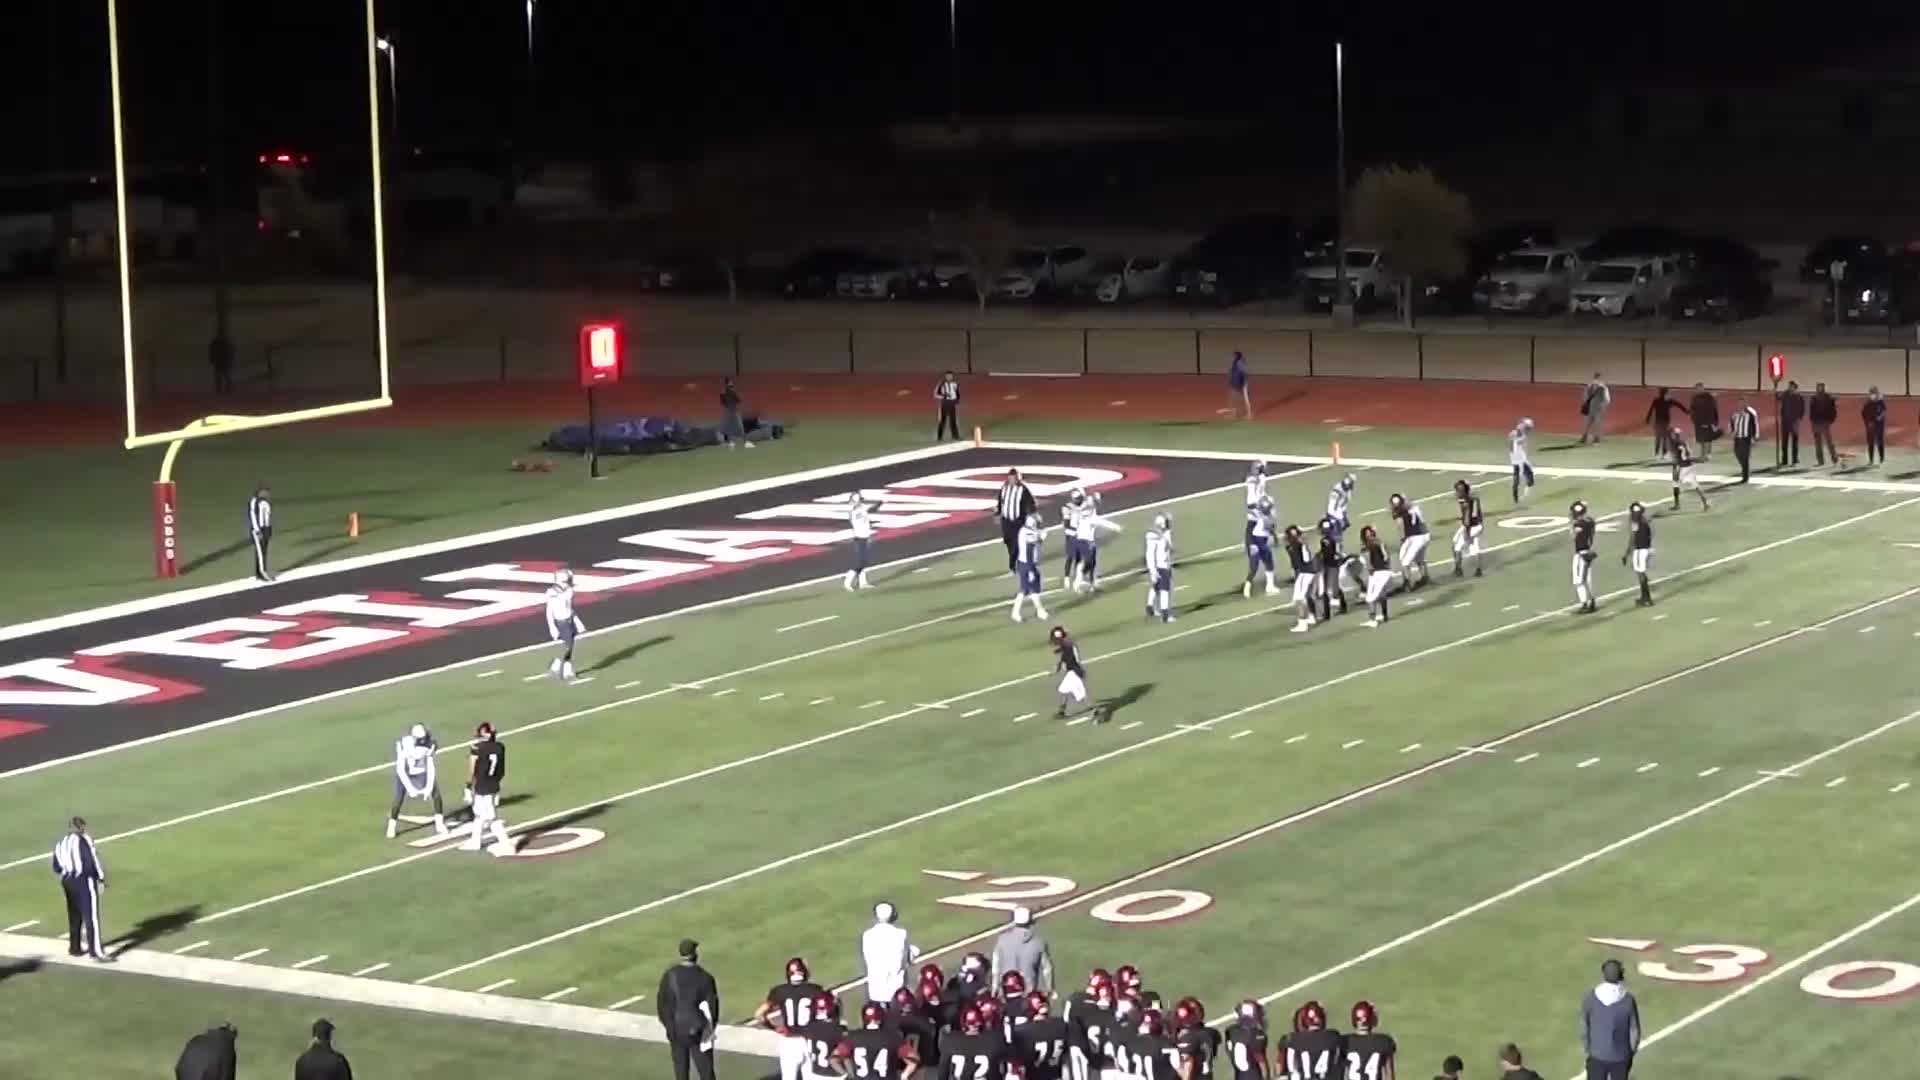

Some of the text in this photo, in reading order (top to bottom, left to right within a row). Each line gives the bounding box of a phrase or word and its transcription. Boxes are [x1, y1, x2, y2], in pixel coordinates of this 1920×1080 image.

[163, 502, 175, 560] LOBOS
[936, 875, 1213, 923] 20
[1637, 944, 1920, 999] 30
[784, 997, 812, 1027] 16
[853, 1046, 889, 1078] 54
[951, 1054, 989, 1080] 72
[1034, 1039, 1065, 1067] 75
